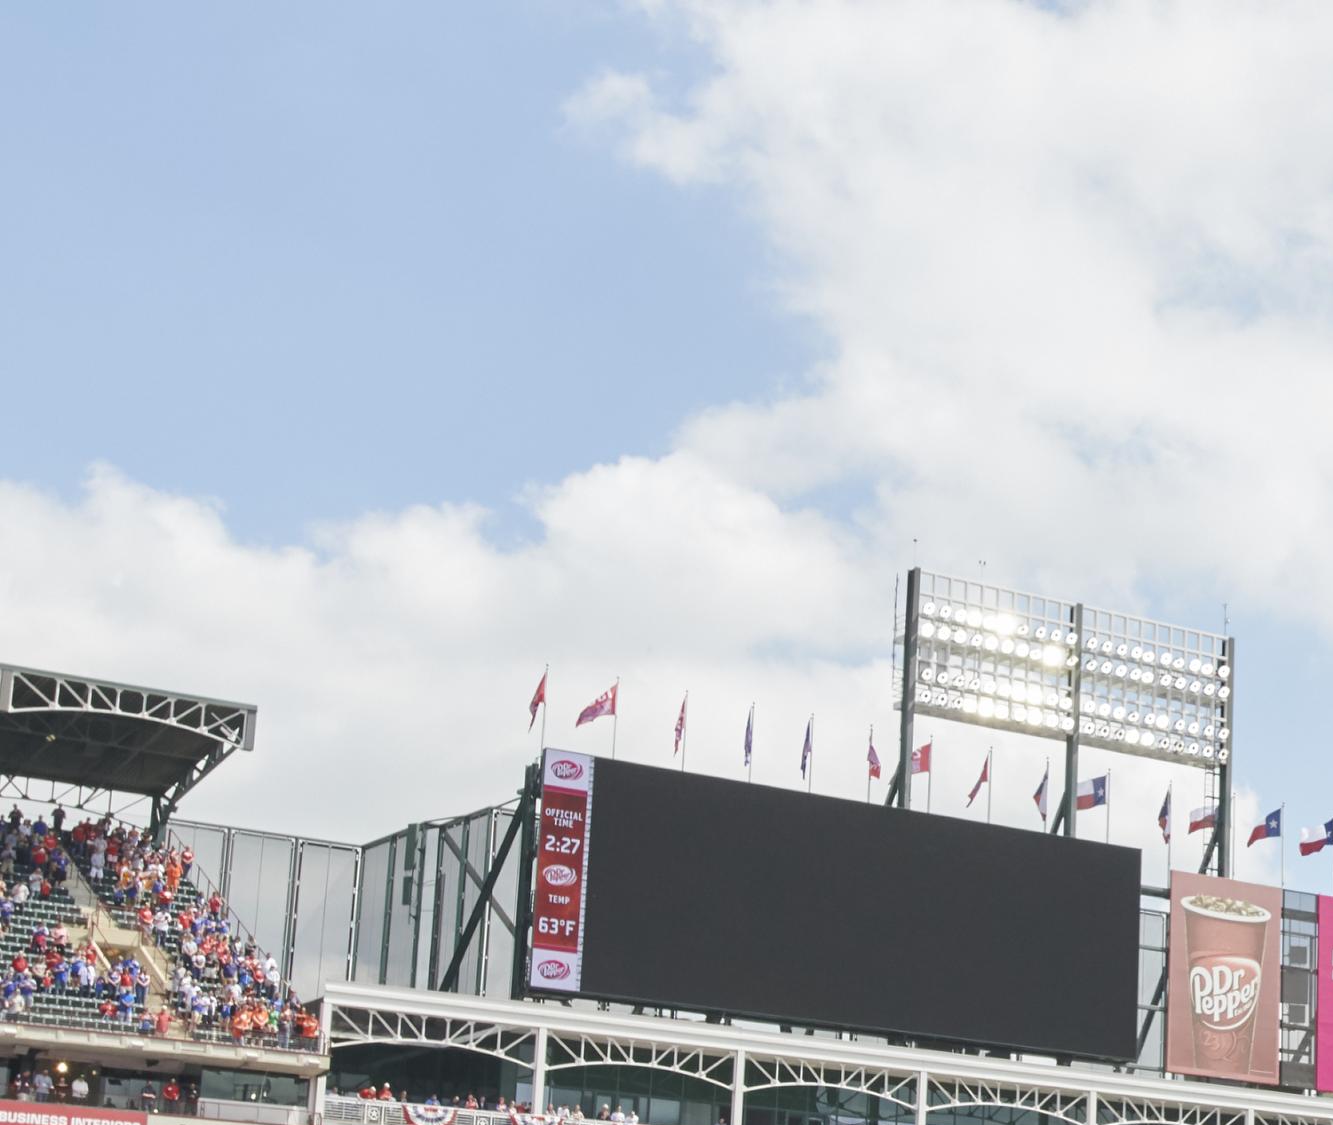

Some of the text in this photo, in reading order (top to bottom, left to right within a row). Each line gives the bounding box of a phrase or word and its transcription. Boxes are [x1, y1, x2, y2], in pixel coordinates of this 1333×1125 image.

[545, 807, 583, 821] OFFICIAL
[553, 818, 574, 828] TIME
[545, 834, 581, 854] 2:27
[548, 894, 570, 905] TEMP
[1212, 965, 1245, 995] Dr
[1190, 966, 1258, 1022] Pepper
